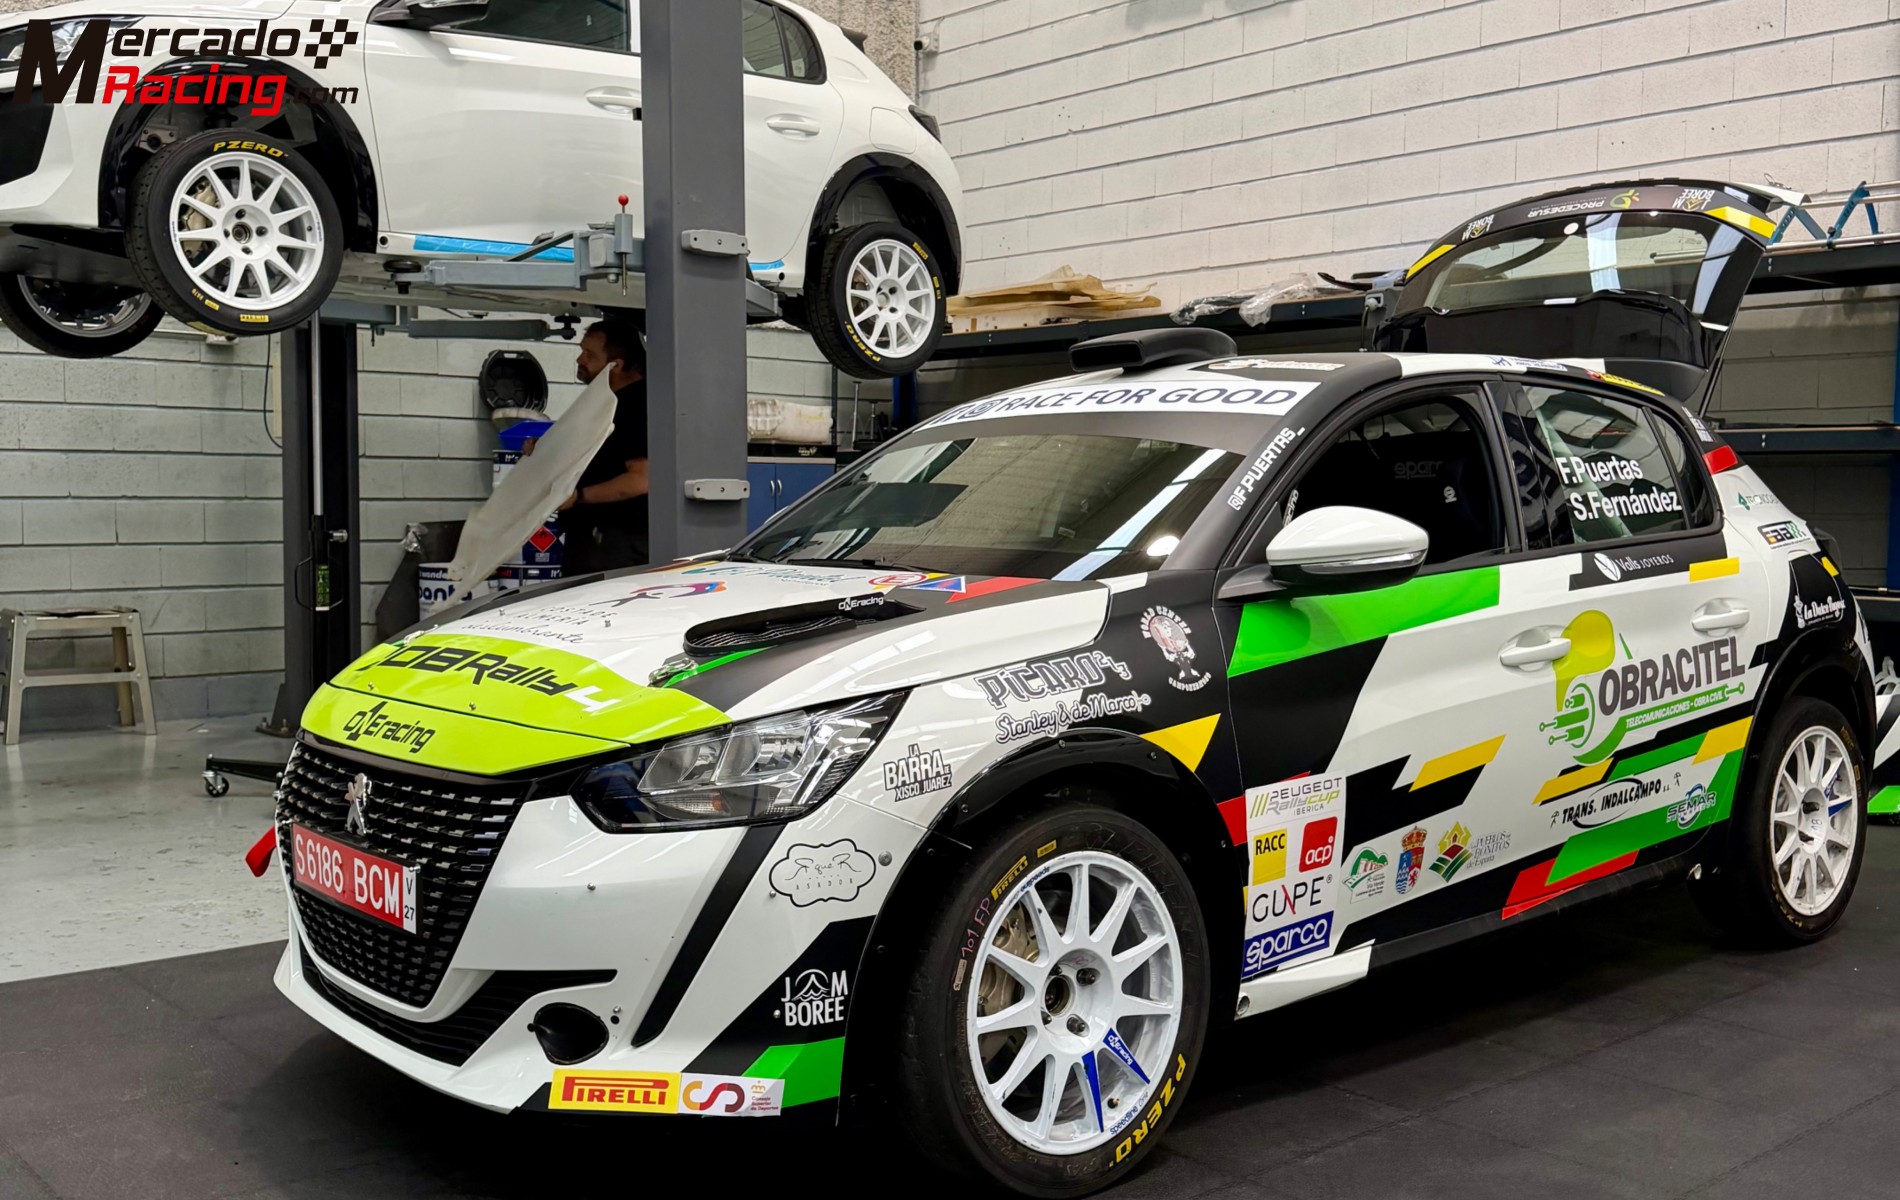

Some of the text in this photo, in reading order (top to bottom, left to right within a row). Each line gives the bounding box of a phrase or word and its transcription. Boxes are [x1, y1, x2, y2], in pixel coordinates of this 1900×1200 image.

[1528, 199, 1605, 218] PROCEDESUR
[995, 387, 1298, 413] RACE FOR GOOD
[1555, 456, 1644, 485] F.Puertas
[1569, 486, 1682, 521] S.Fernández
[1641, 553, 1675, 569] JOYEROS
[1599, 636, 1745, 716] OBRACITEL
[995, 711, 1059, 744] Stanley
[1058, 701, 1071, 726] &
[1070, 701, 1091, 721] de
[908, 743, 920, 757] LA
[884, 749, 944, 791] BARRA
[895, 775, 951, 802] XISCO JUAREZ
[1270, 777, 1342, 802] PEUGEOT
[1562, 800, 1597, 824] TRANS.
[1600, 778, 1661, 812] INDALCAMPO
[1293, 803, 1324, 816] IBERICA
[1667, 791, 1716, 818] SEMAR
[1255, 832, 1286, 856] RACC
[353, 857, 400, 919] BCM
[405, 877, 413, 896] V
[991, 855, 1029, 900] PIRELLI
[404, 904, 415, 921] 27
[1245, 918, 1328, 970] sparco
[785, 996, 845, 1027] BOREE
[561, 1076, 670, 1106] PIRELLI
[1115, 1053, 1186, 1164] PZERO
